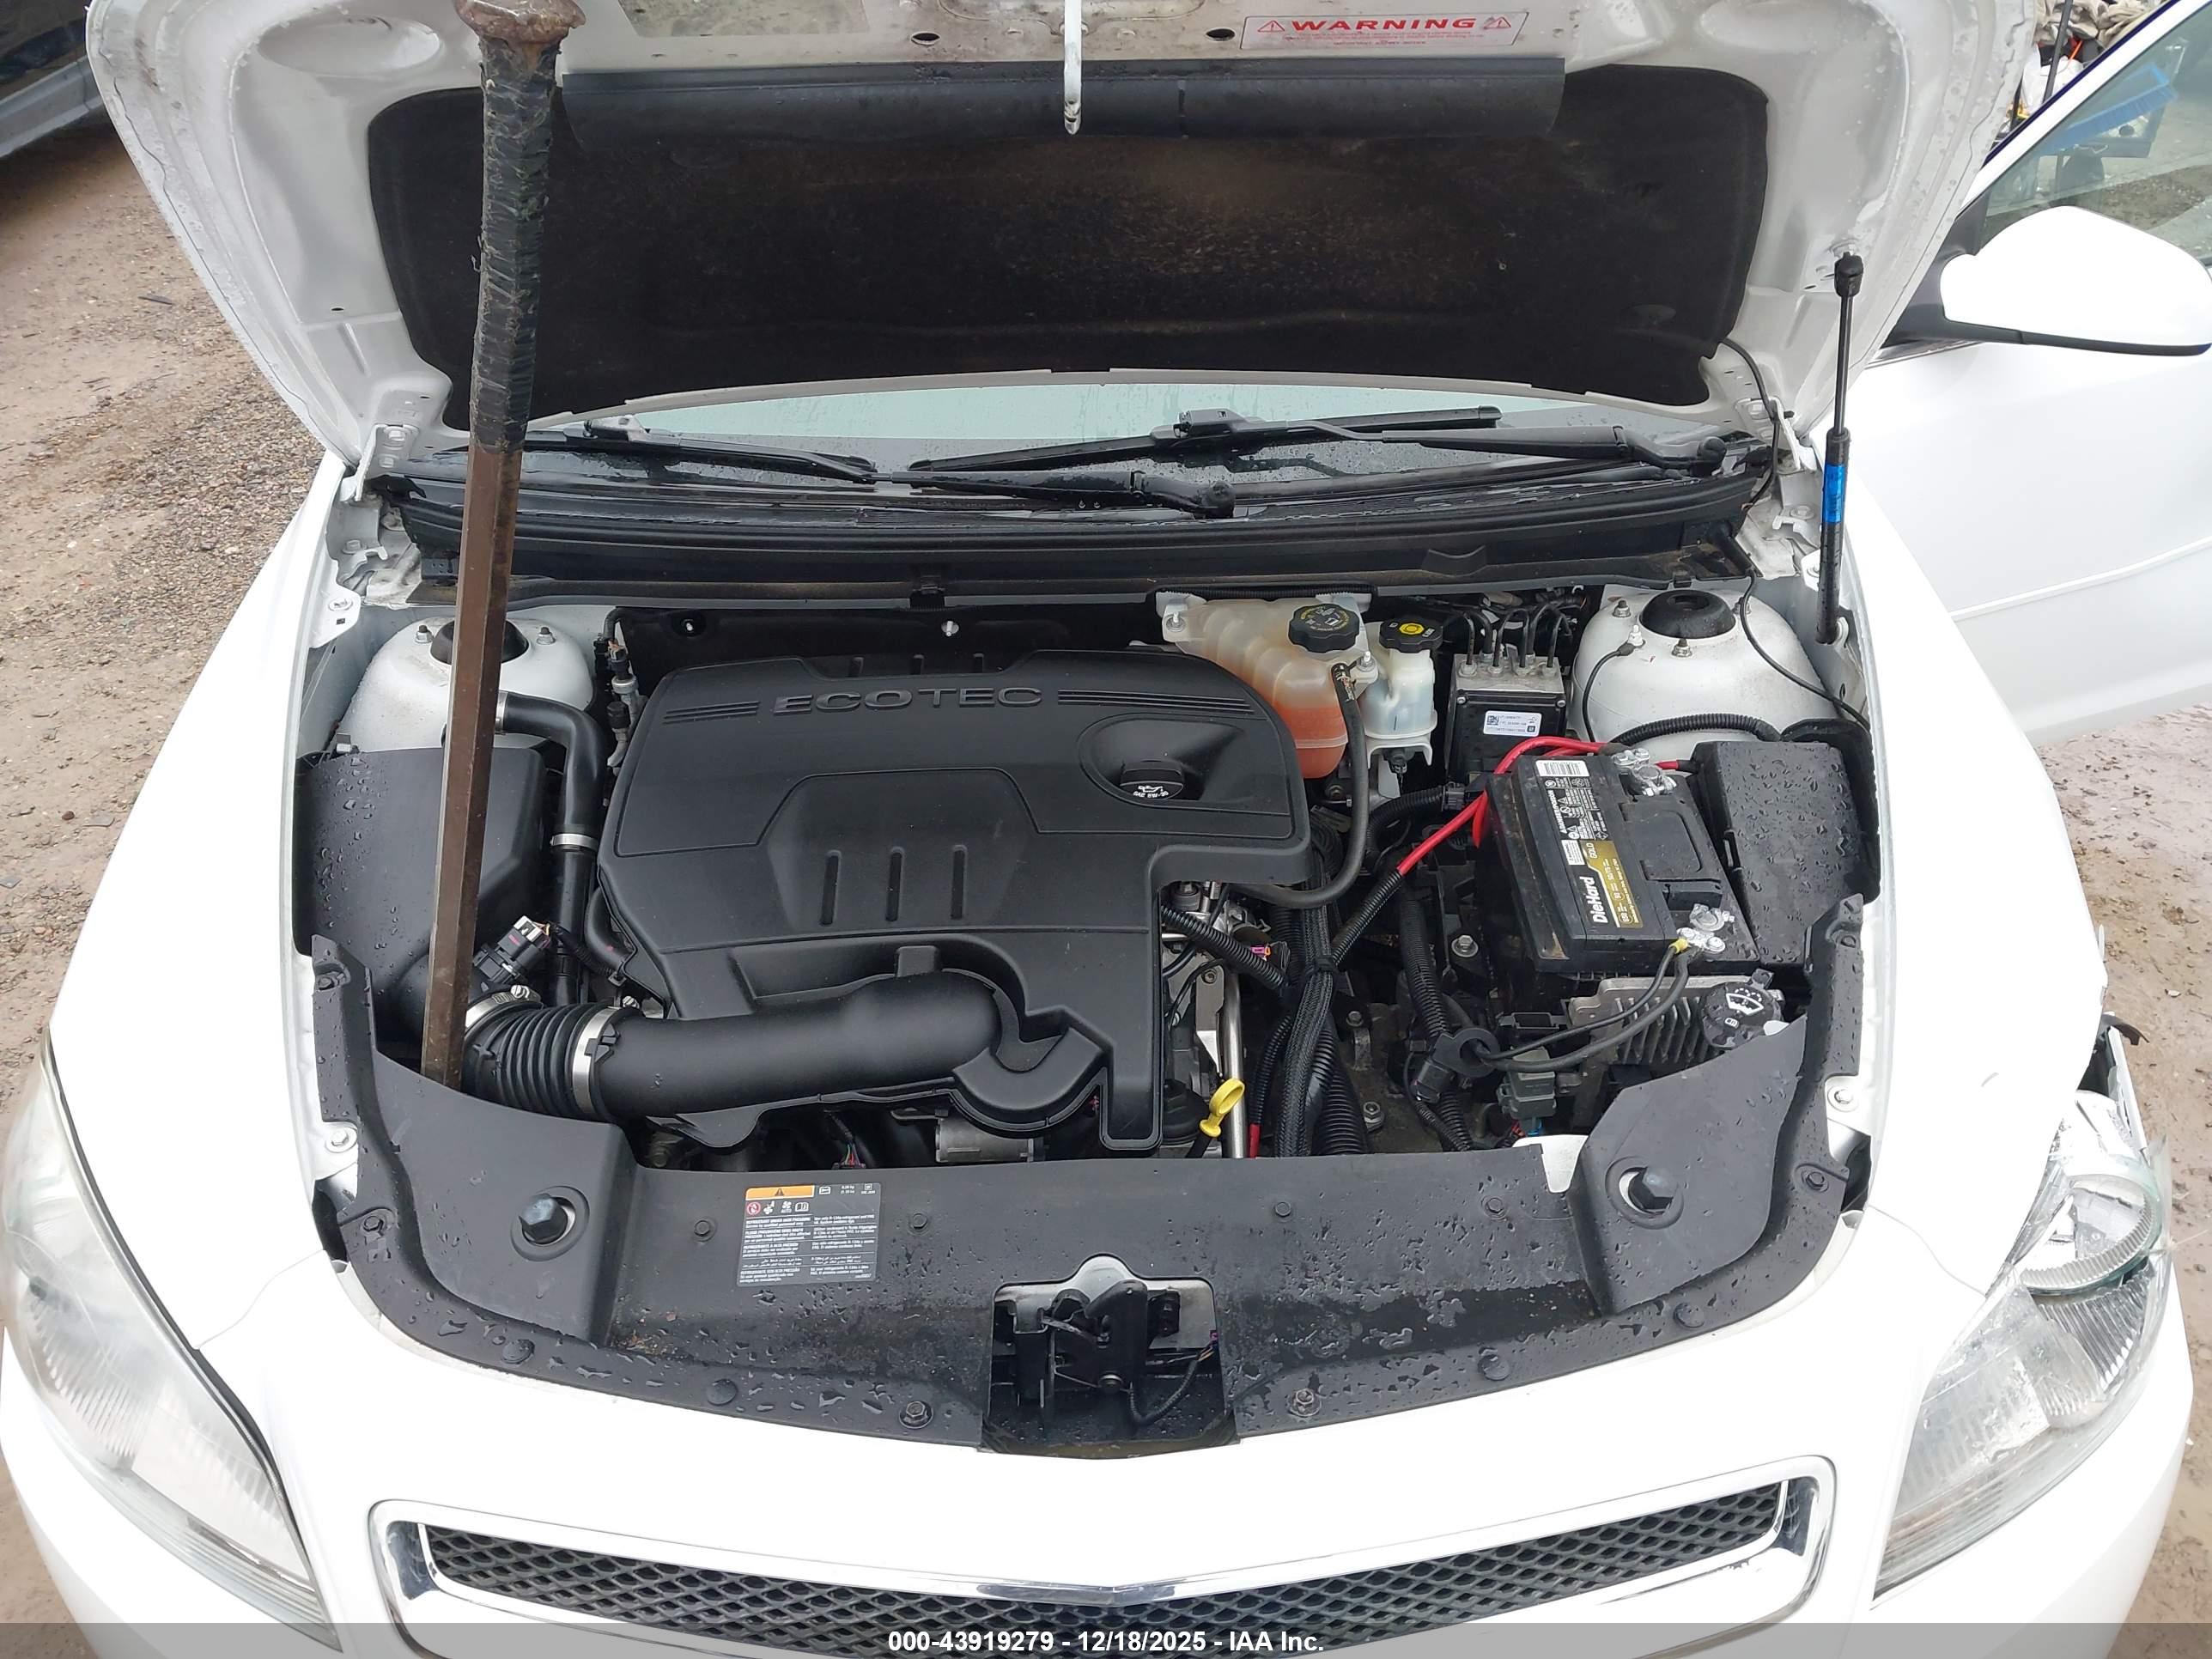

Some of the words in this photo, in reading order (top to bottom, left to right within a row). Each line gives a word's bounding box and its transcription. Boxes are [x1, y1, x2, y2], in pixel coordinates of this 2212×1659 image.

[1291, 18, 1477, 32] WARNING
[773, 686, 1042, 716] ECOTEC
[1585, 842, 1598, 859] GOLD
[1578, 876, 1608, 924] DieHard
